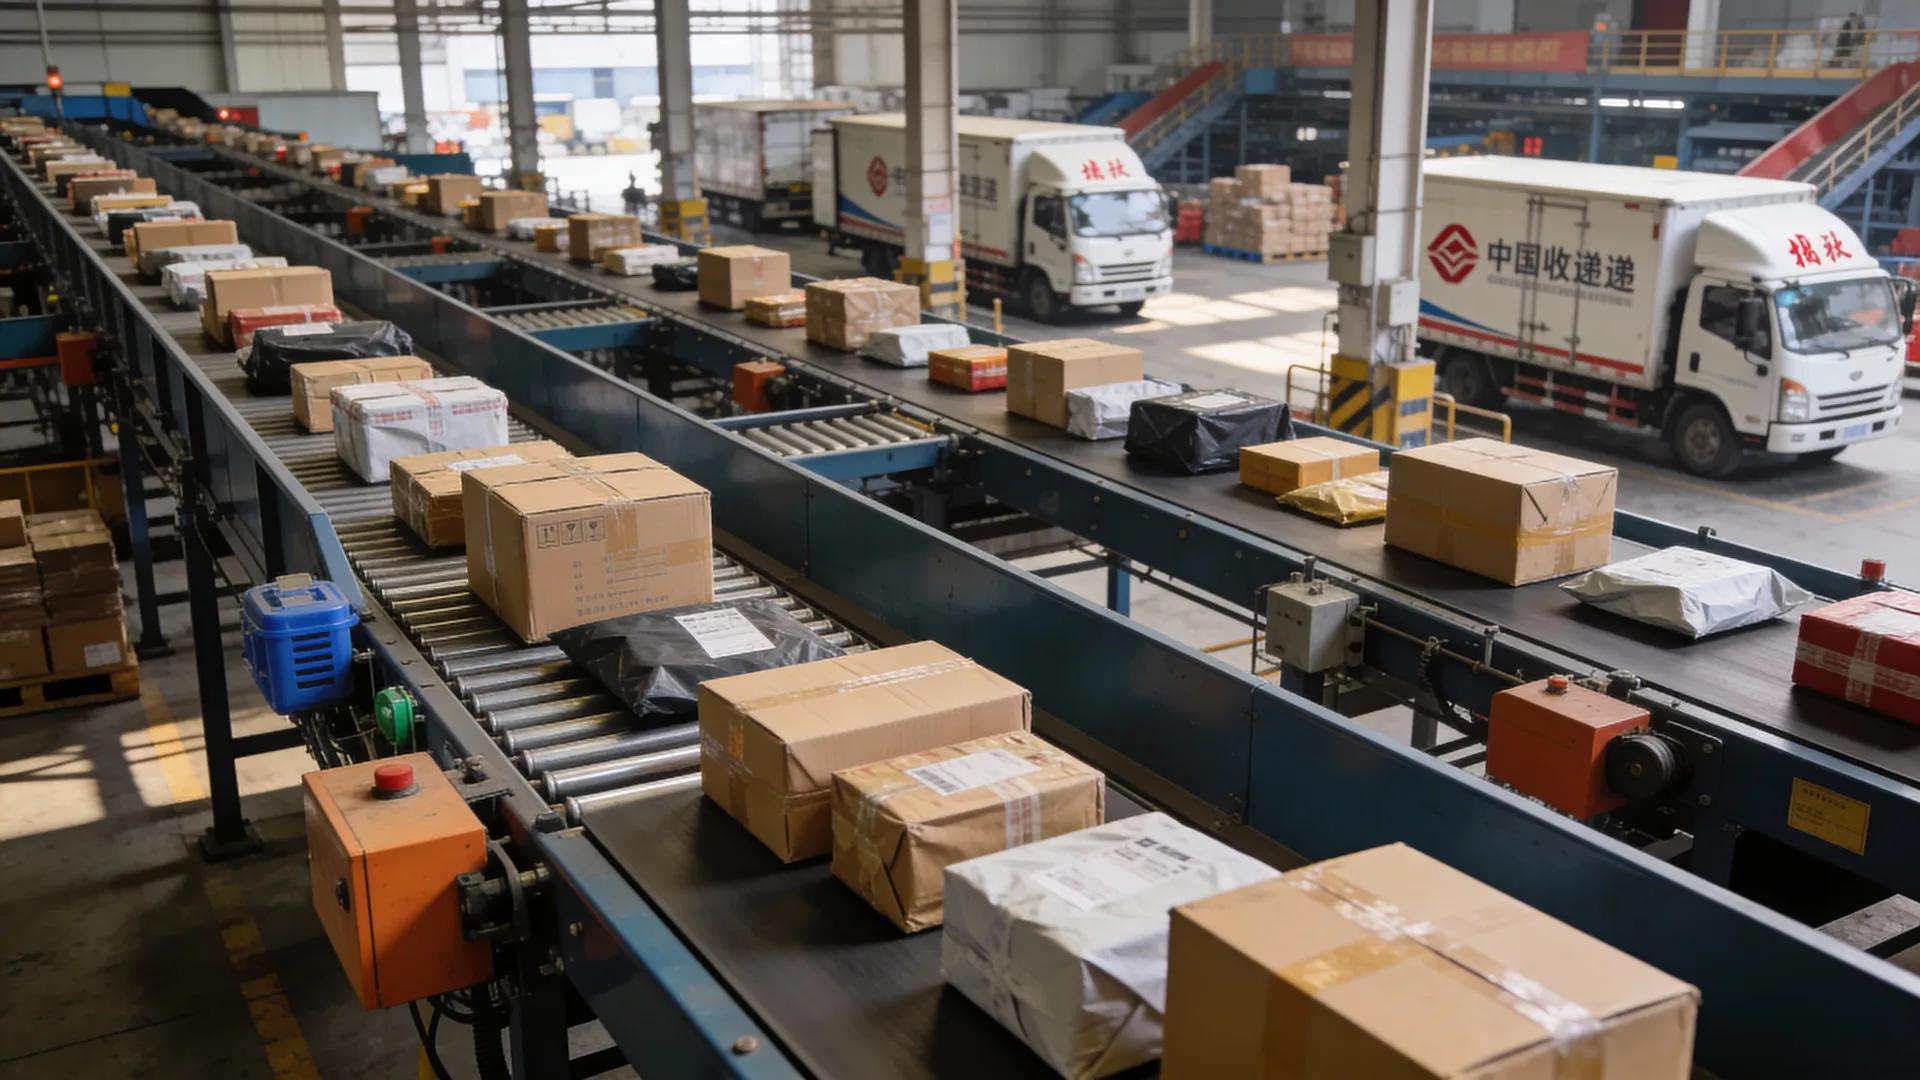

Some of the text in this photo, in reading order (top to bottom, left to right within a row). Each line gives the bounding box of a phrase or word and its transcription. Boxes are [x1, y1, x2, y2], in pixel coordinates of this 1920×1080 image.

[1487, 237, 1635, 293] 中国收递递
